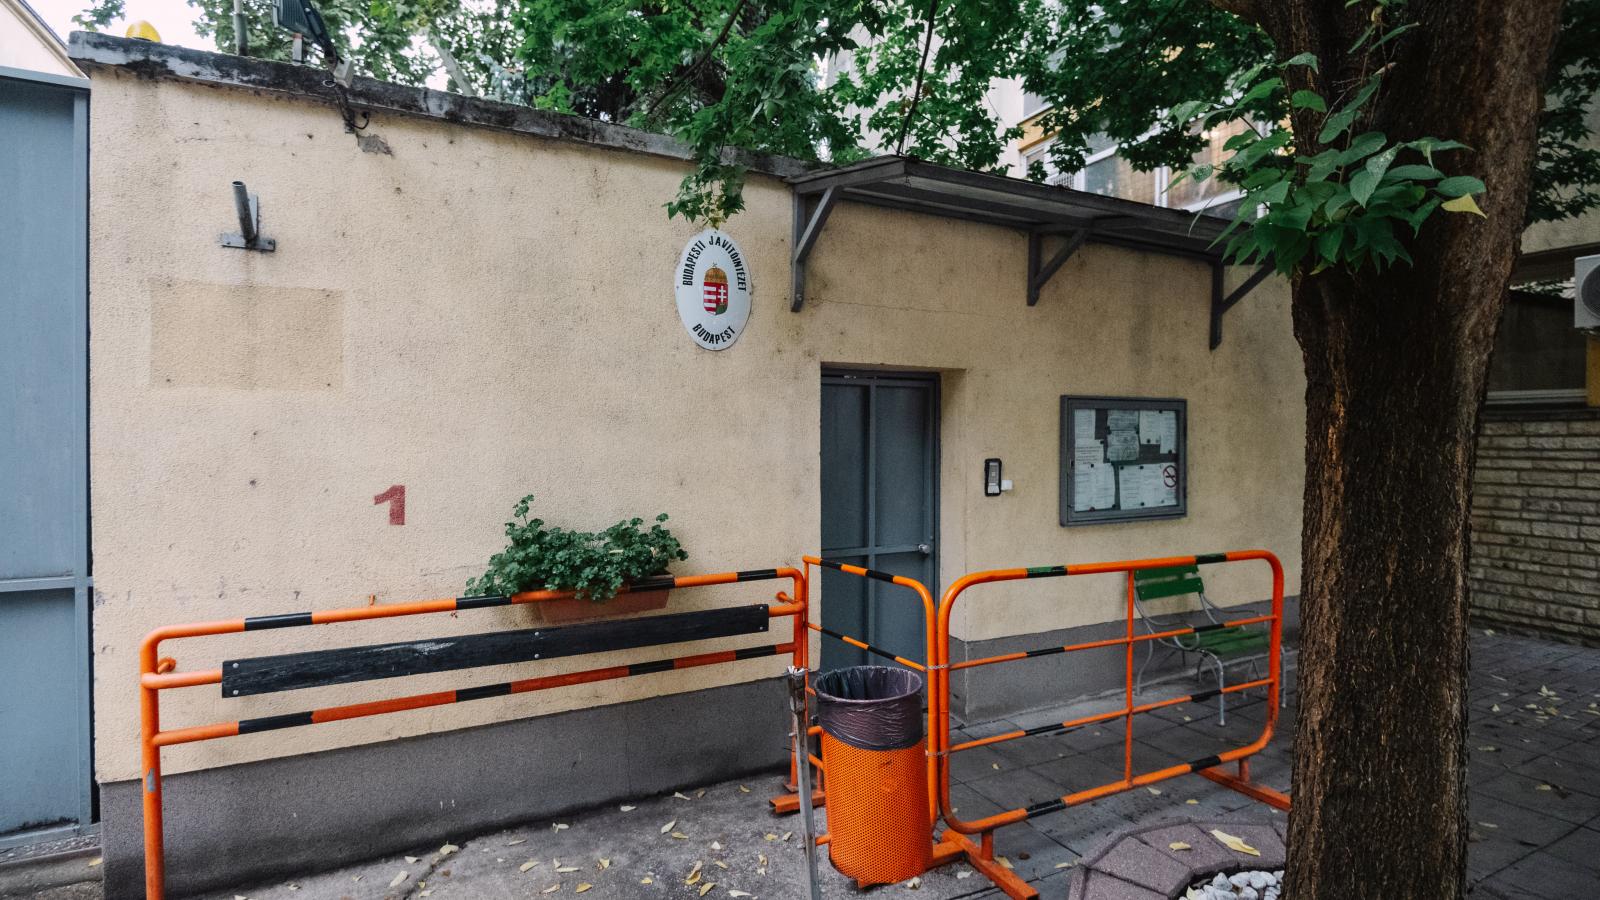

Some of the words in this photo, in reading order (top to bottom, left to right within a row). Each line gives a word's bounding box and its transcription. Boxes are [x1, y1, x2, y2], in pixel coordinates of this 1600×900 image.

[682, 240, 706, 286] BUDAPESTI
[692, 323, 736, 345] BUDAPEST
[374, 485, 406, 526] 1
